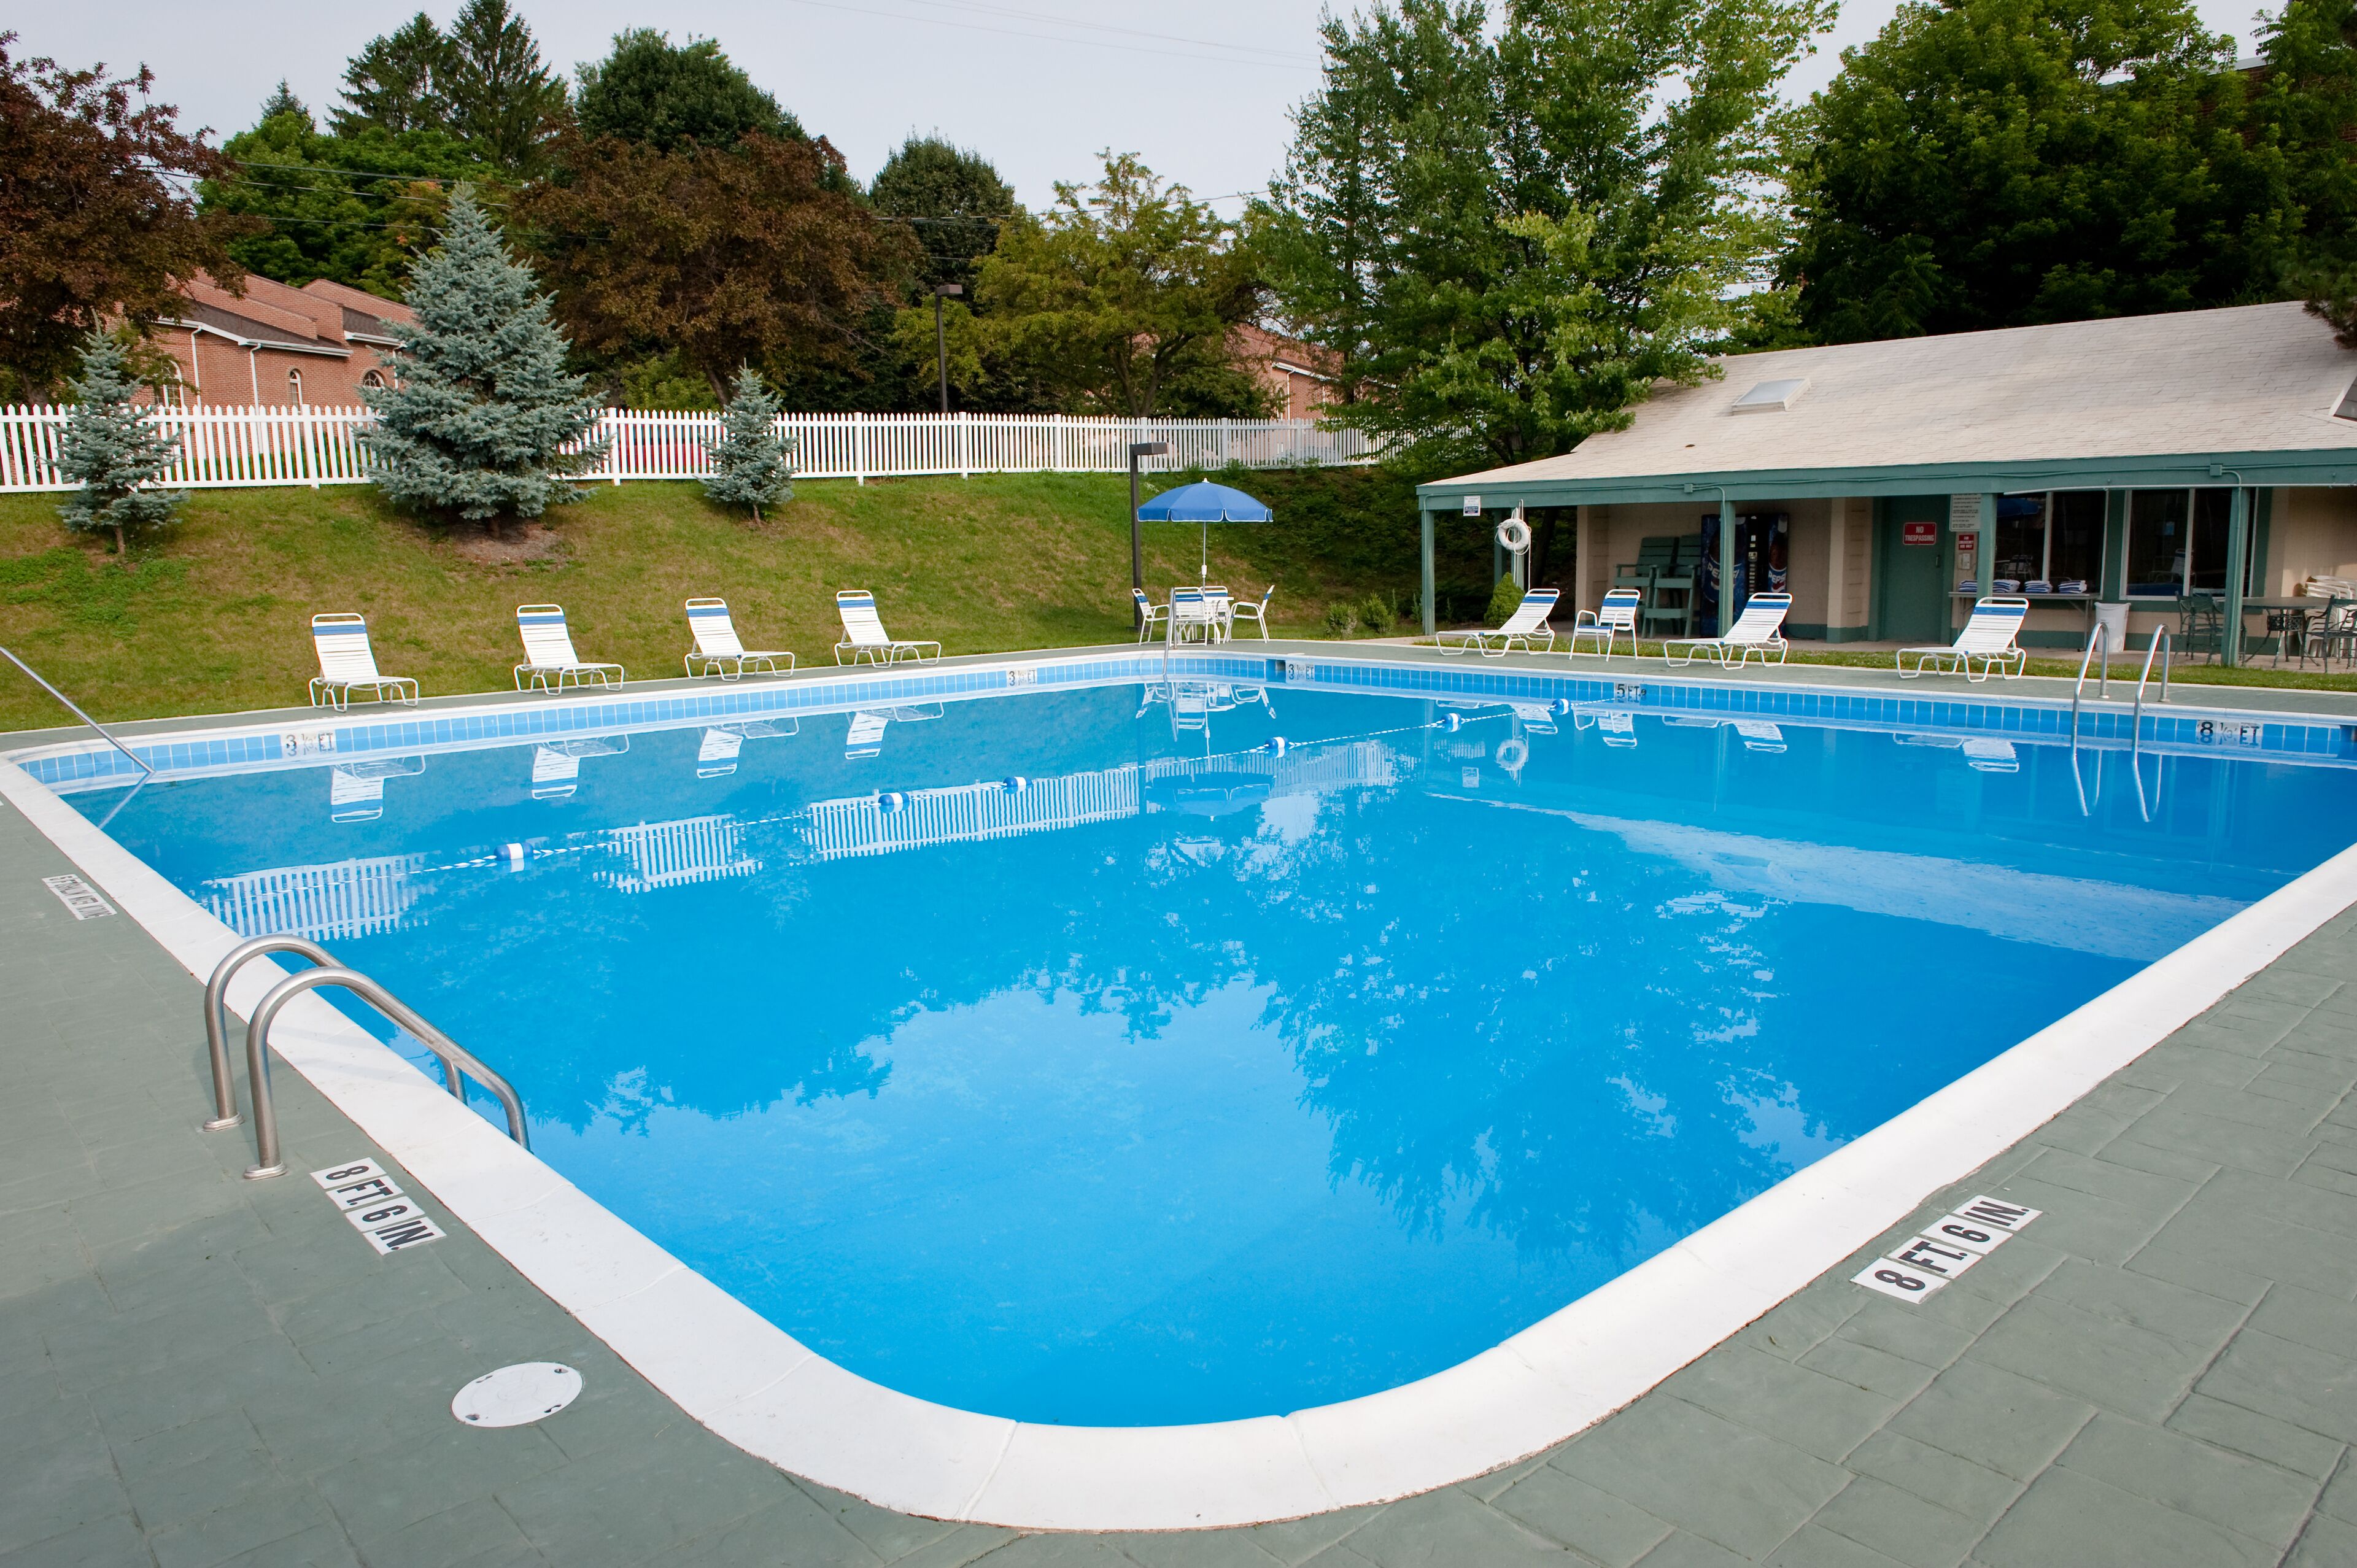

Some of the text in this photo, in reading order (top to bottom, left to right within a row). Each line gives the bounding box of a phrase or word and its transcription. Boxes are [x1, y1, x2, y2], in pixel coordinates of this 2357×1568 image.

[1617, 684, 1625, 698] 5
[2200, 721, 2213, 739] 8
[326, 1165, 435, 1250] 8 FT. 6 IN.
[1875, 1200, 2029, 1291] 8 FT. 6 IN.
